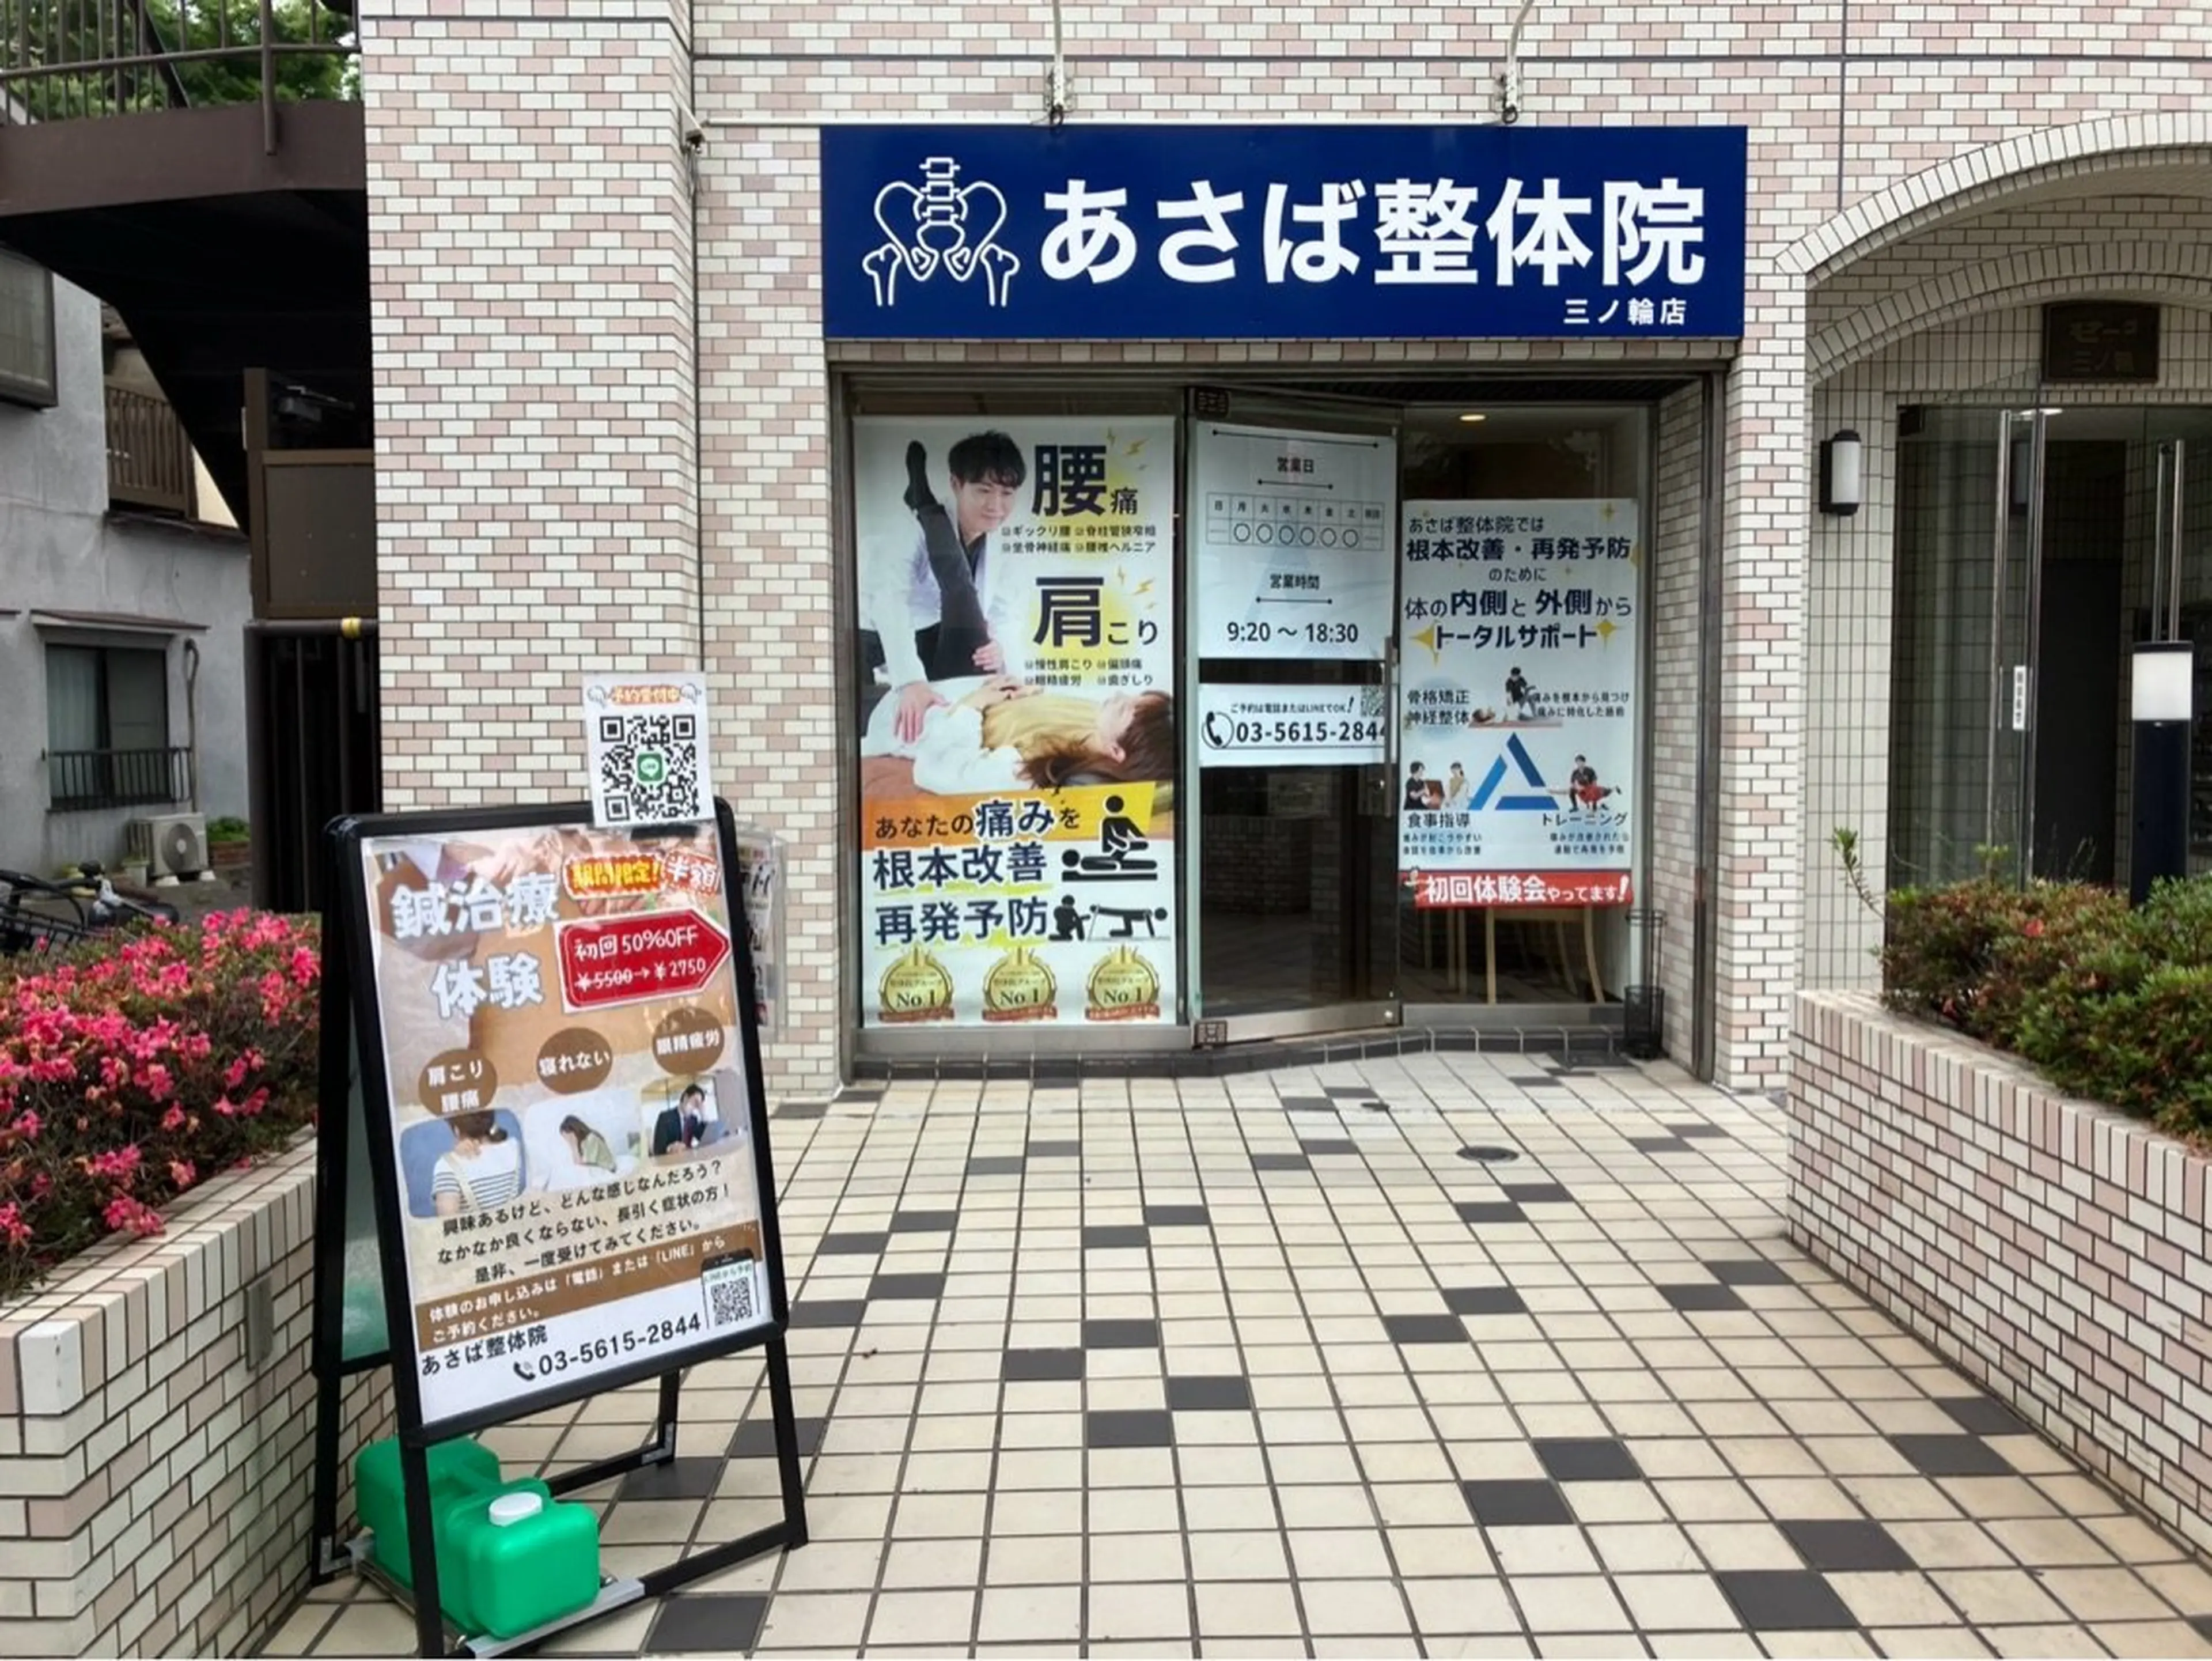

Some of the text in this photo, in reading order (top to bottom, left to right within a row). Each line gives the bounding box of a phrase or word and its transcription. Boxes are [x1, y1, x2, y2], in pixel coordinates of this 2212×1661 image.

[1040, 179, 1705, 287] あさば整体院
[1564, 298, 1687, 325] 三ノ輪店
[1031, 444, 1138, 516] 腰痛
[1277, 457, 1314, 474] 営業日
[1409, 517, 1544, 534] あさば整体院では
[1406, 538, 1631, 561] 根本改善・再発予防
[1270, 574, 1320, 589] 営業時間
[1489, 567, 1547, 582] のために
[1033, 576, 1158, 648] 肩こり
[1437, 623, 1597, 649] トータルサポート
[1407, 690, 1470, 705] 骨格矯正
[1407, 710, 1470, 725] 神経整体
[876, 800, 1080, 838] あなたの痛みを
[1407, 812, 1471, 828] 食事指導
[1543, 812, 1628, 827] トレーニング
[666, 855, 716, 888] 半額
[873, 842, 1047, 890] 根本改善
[389, 873, 559, 939] 鍼治療
[875, 897, 1048, 944] 再発予防
[430, 955, 544, 1017] 体験
[428, 1060, 483, 1088] 肩こり
[433, 1308, 540, 1344] ご予約ください。
[422, 1324, 548, 1376] あさば整体院
[539, 1312, 701, 1376] 03-5615-2844
